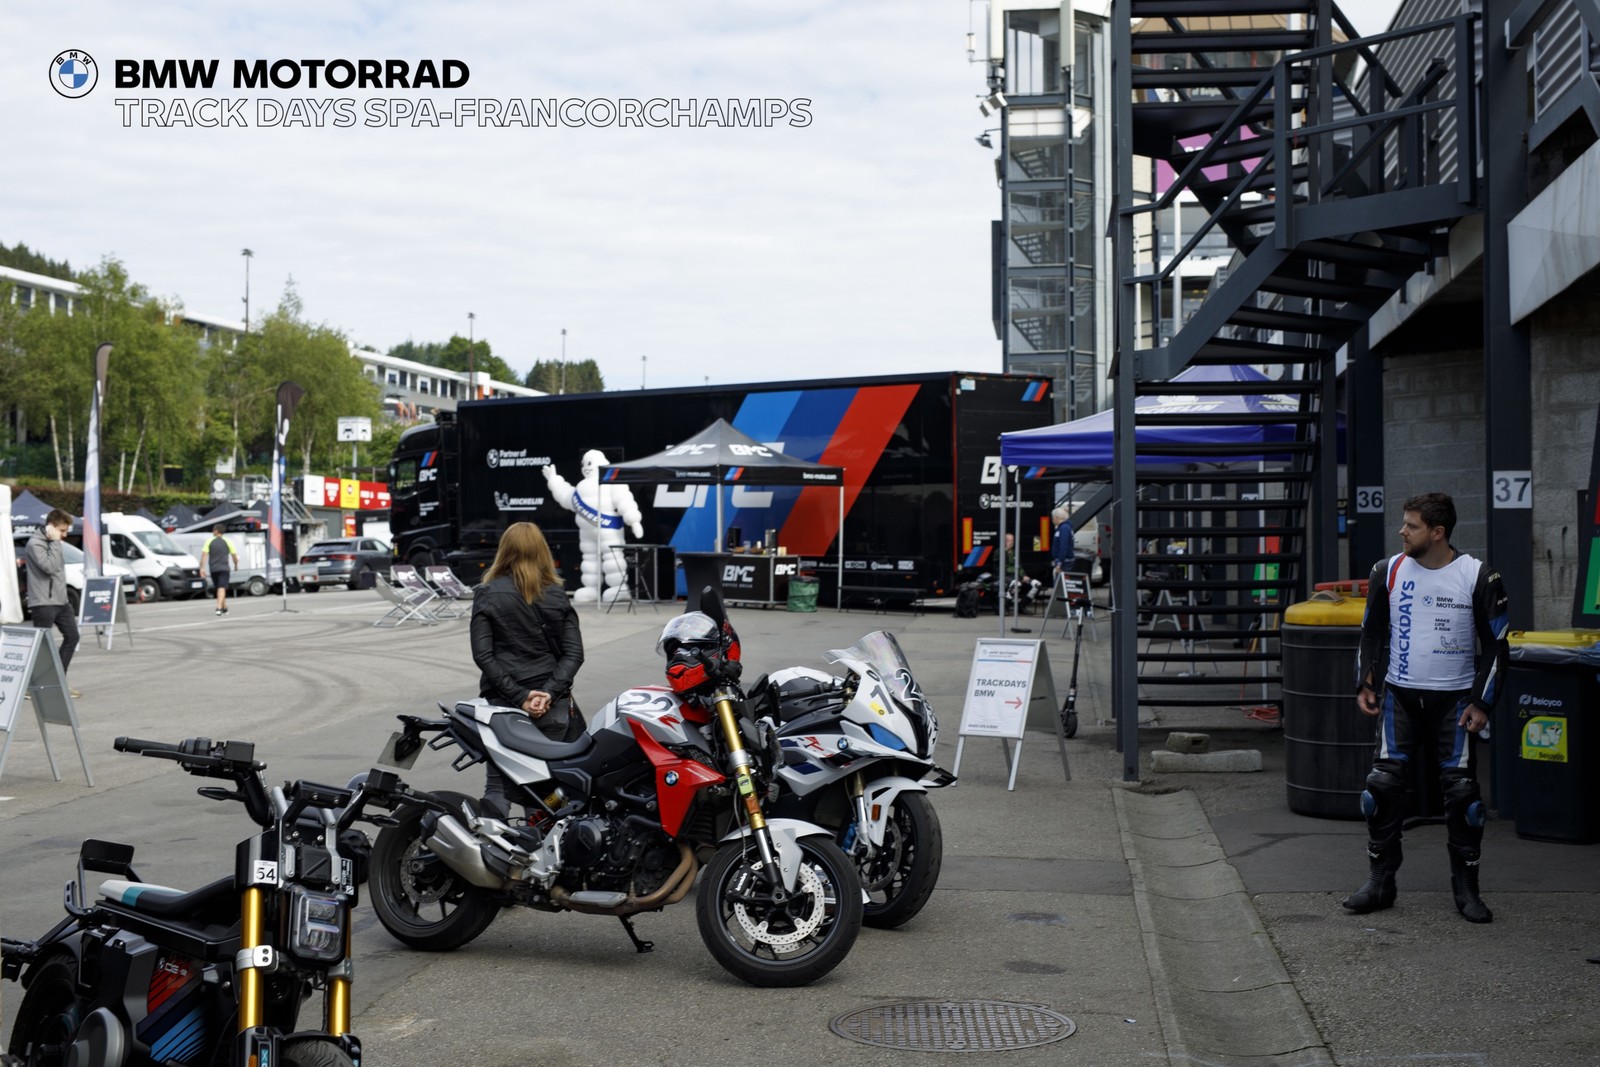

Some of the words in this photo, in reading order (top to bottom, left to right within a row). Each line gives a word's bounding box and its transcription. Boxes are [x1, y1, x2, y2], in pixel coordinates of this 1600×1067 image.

[500, 459, 515, 467] BMW
[516, 457, 551, 466] MOTORRAD
[1495, 477, 1531, 503] 37
[510, 498, 544, 506] MICHELIN
[1358, 490, 1383, 509] 36
[722, 565, 755, 583] BMC
[774, 564, 796, 575] BMC
[1397, 580, 1416, 682] TRACKDAYS
[976, 679, 1027, 688] TRACKDAYS
[617, 692, 674, 719] 22
[1532, 697, 1562, 707] Belcyco
[256, 868, 276, 881] 54
